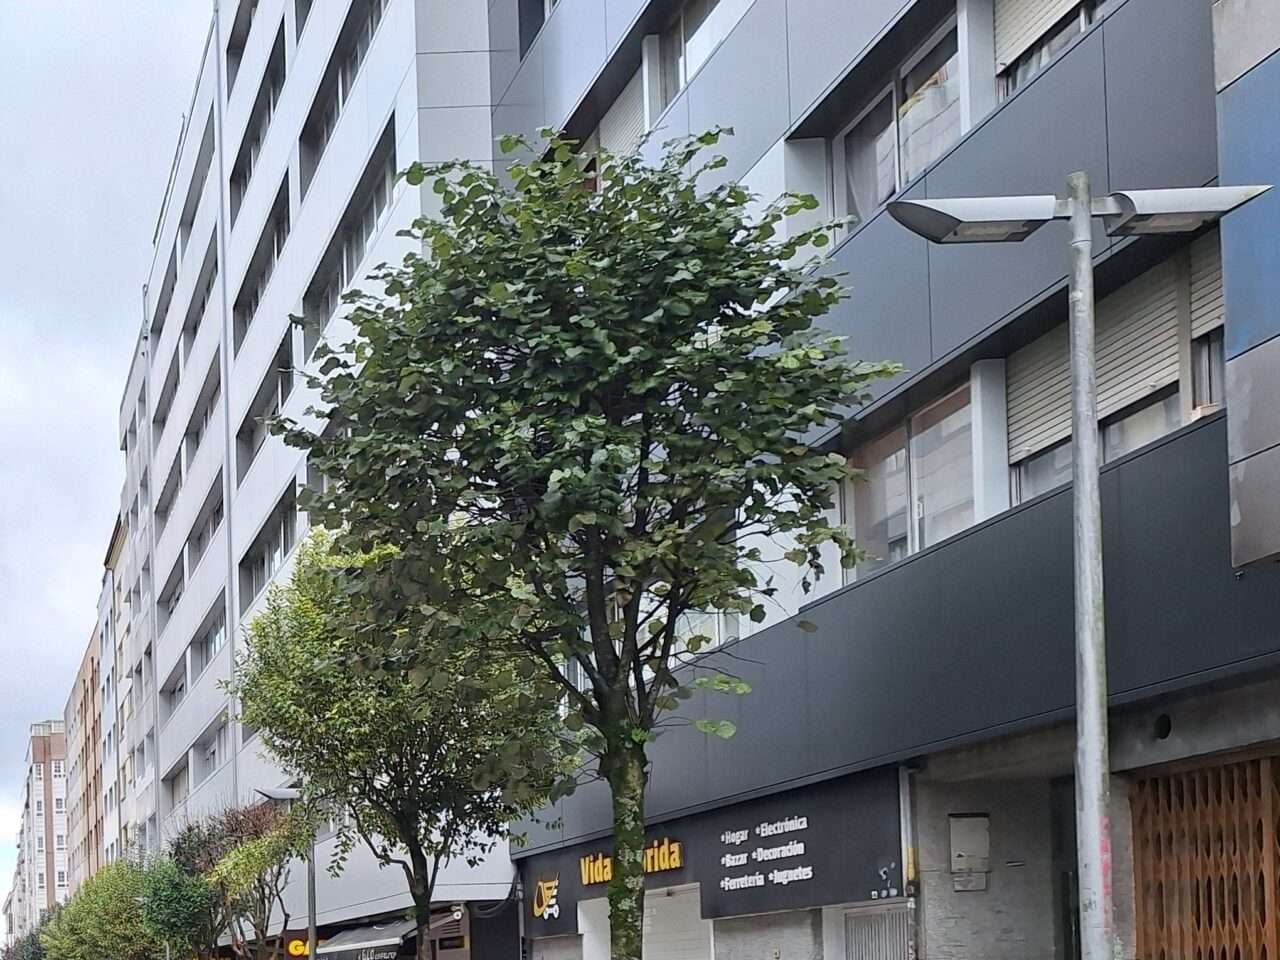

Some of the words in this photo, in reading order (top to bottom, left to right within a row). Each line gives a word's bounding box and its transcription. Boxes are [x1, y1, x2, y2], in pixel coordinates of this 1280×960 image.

[725, 829, 749, 845] Hogar
[760, 815, 808, 837] Electrónica
[580, 852, 613, 886] Vida
[643, 837, 683, 873] rida
[725, 853, 749, 868] Bazar
[757, 840, 805, 862] Decoración
[724, 871, 765, 891] Ferretería
[773, 866, 813, 885] Juguetes
